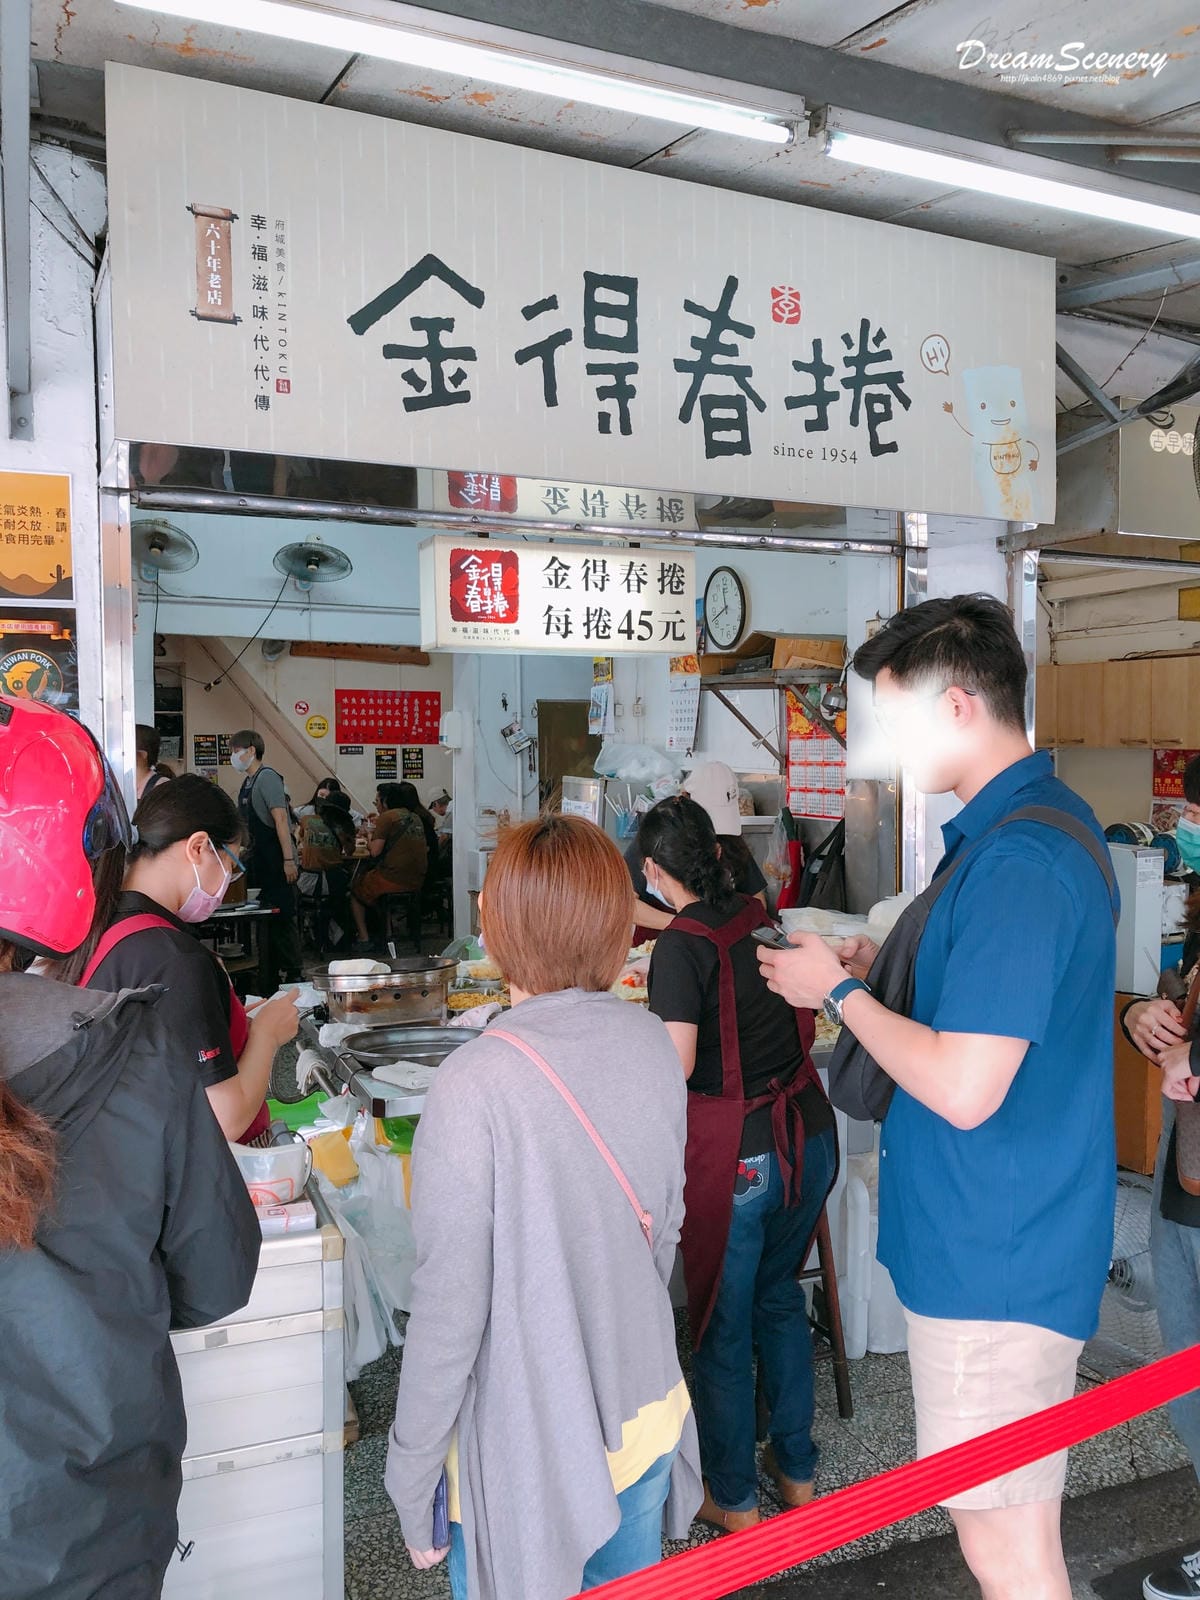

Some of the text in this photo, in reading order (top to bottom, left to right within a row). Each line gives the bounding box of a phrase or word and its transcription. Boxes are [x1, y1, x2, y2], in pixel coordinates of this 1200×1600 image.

[205, 223, 222, 306] 六十年老店
[346, 252, 912, 460] 金得春捲
[926, 340, 946, 367] Hi
[773, 443, 858, 465] since 1954
[542, 556, 686, 595] 金得春捲
[543, 605, 687, 642] 每捲45元
[0, 652, 53, 671] TAIWAN PORK
